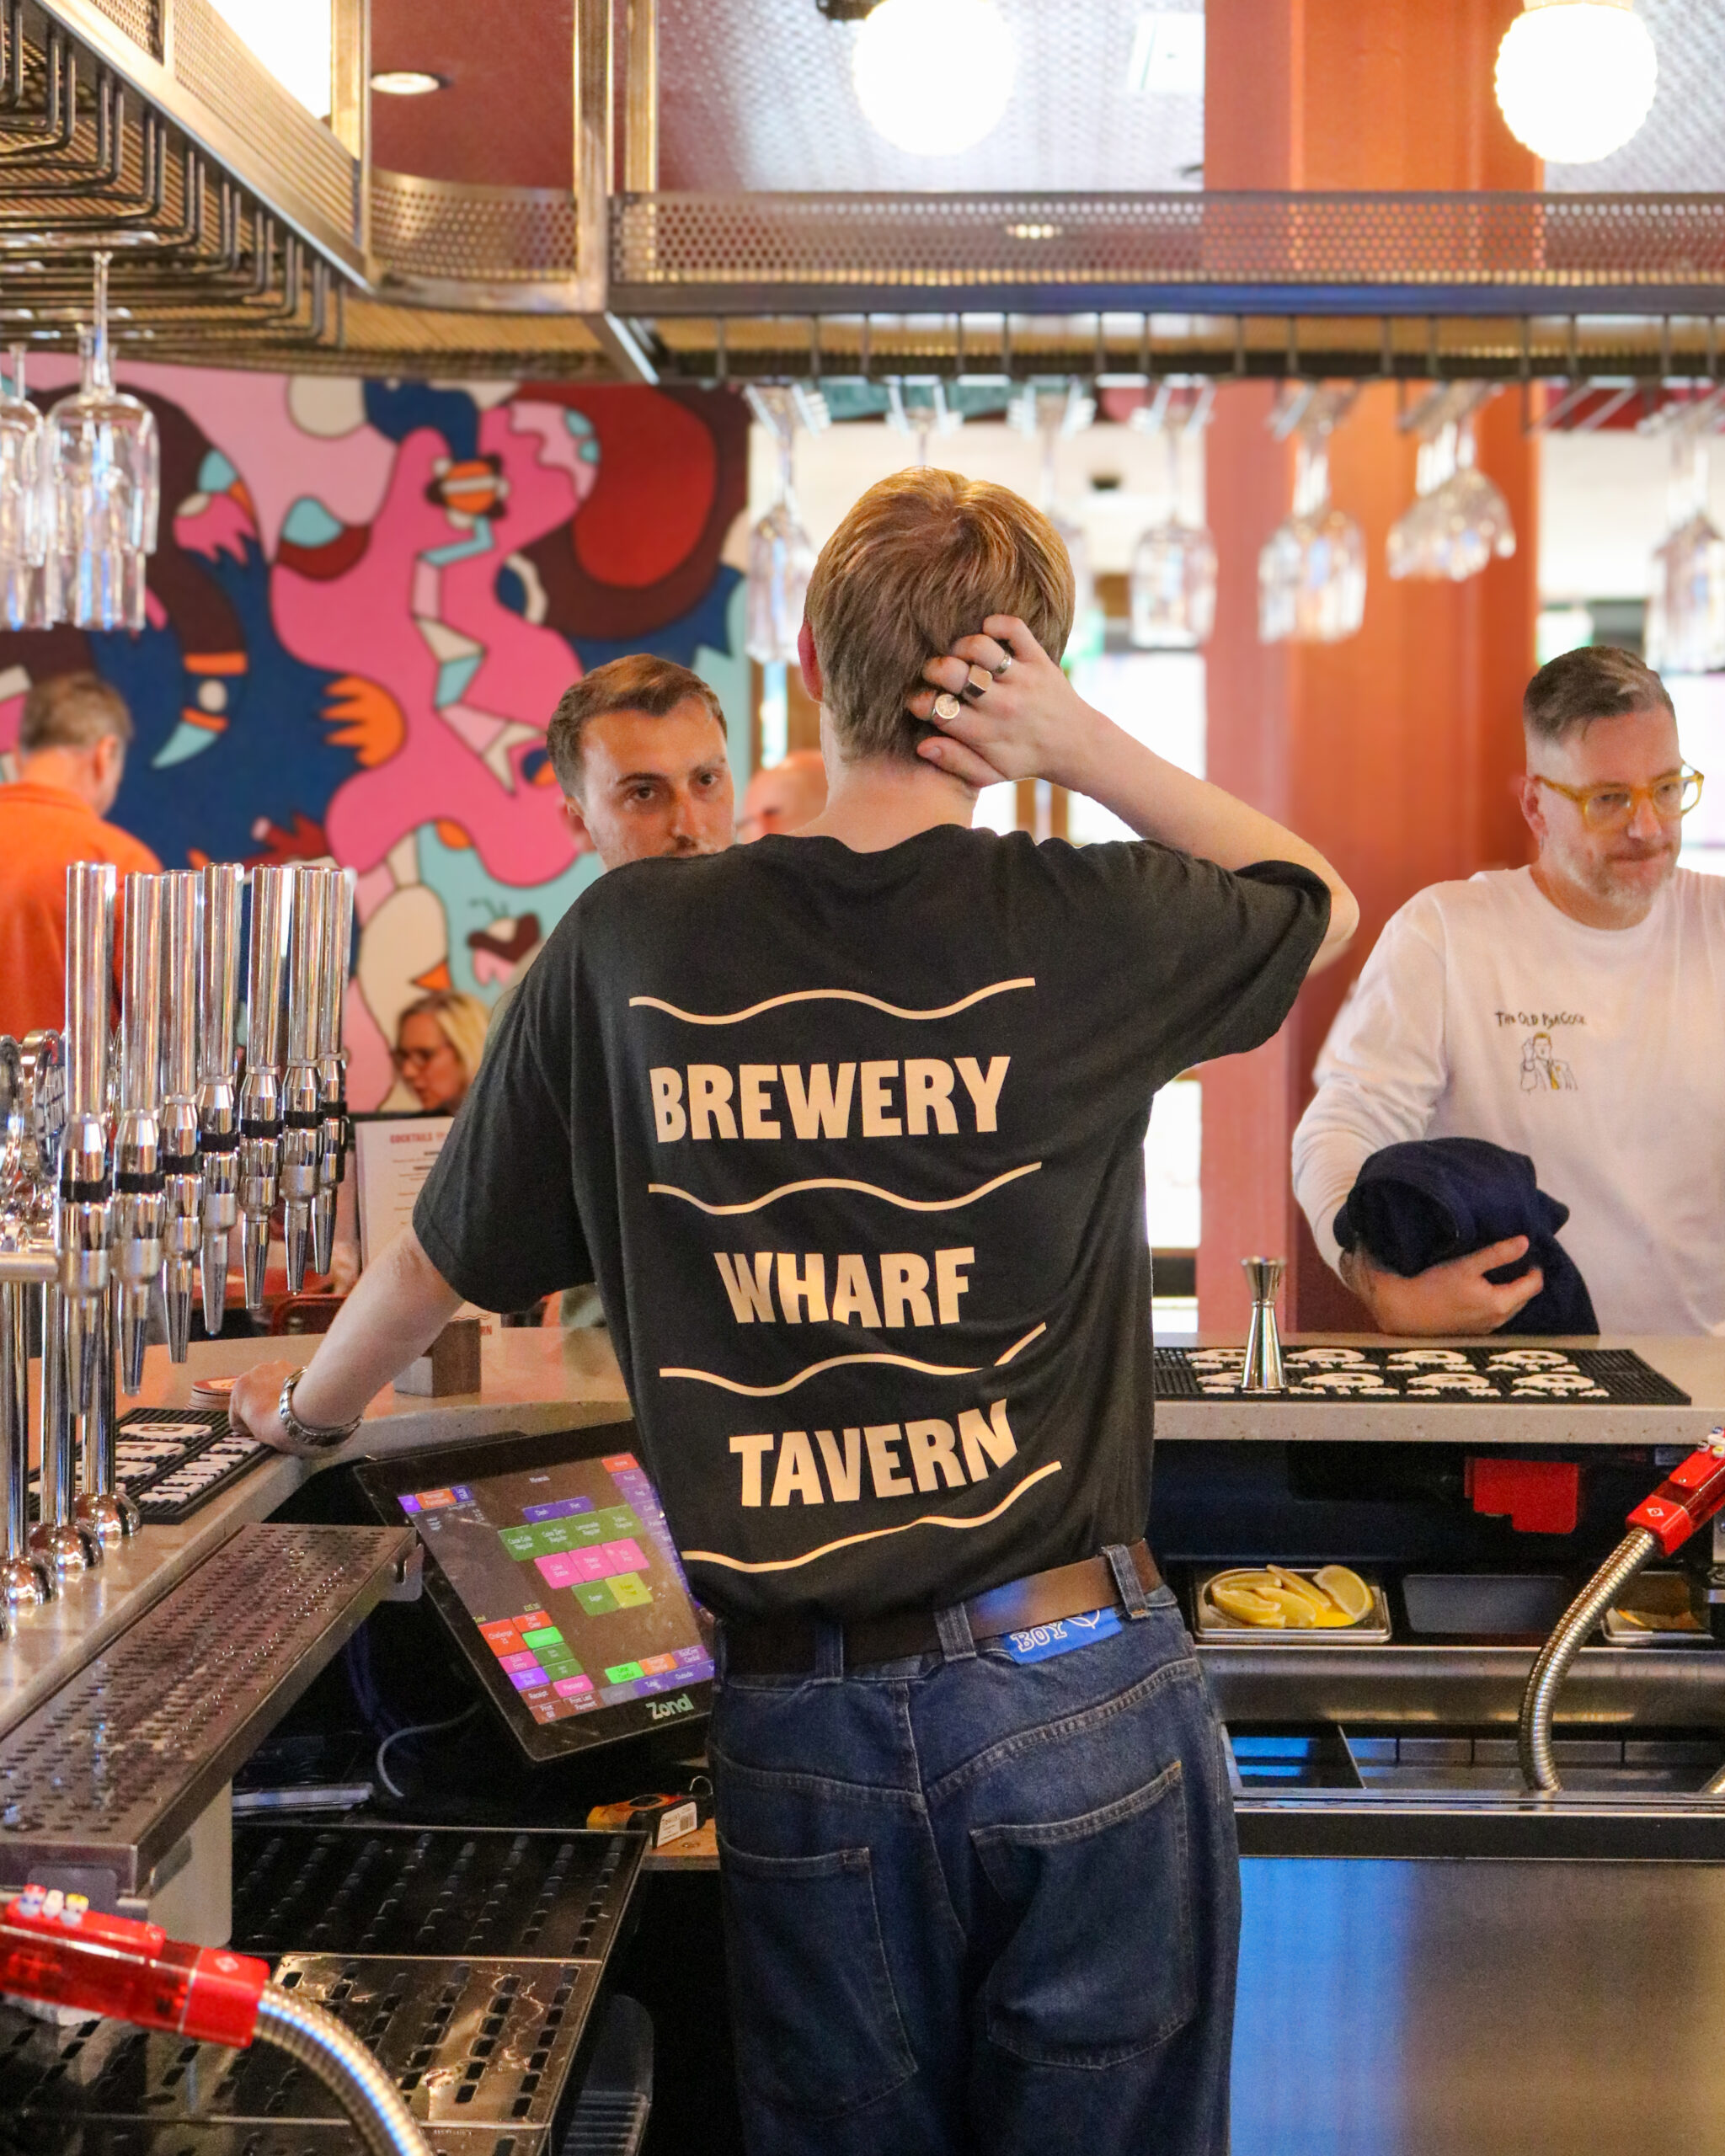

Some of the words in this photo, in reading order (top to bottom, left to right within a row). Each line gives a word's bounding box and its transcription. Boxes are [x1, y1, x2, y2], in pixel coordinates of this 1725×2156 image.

[649, 1056, 1011, 1143] BREWERY
[713, 1246, 975, 1328] WHARF
[729, 1398, 1017, 1508] TAVERN
[1010, 1620, 1067, 1652] BOY
